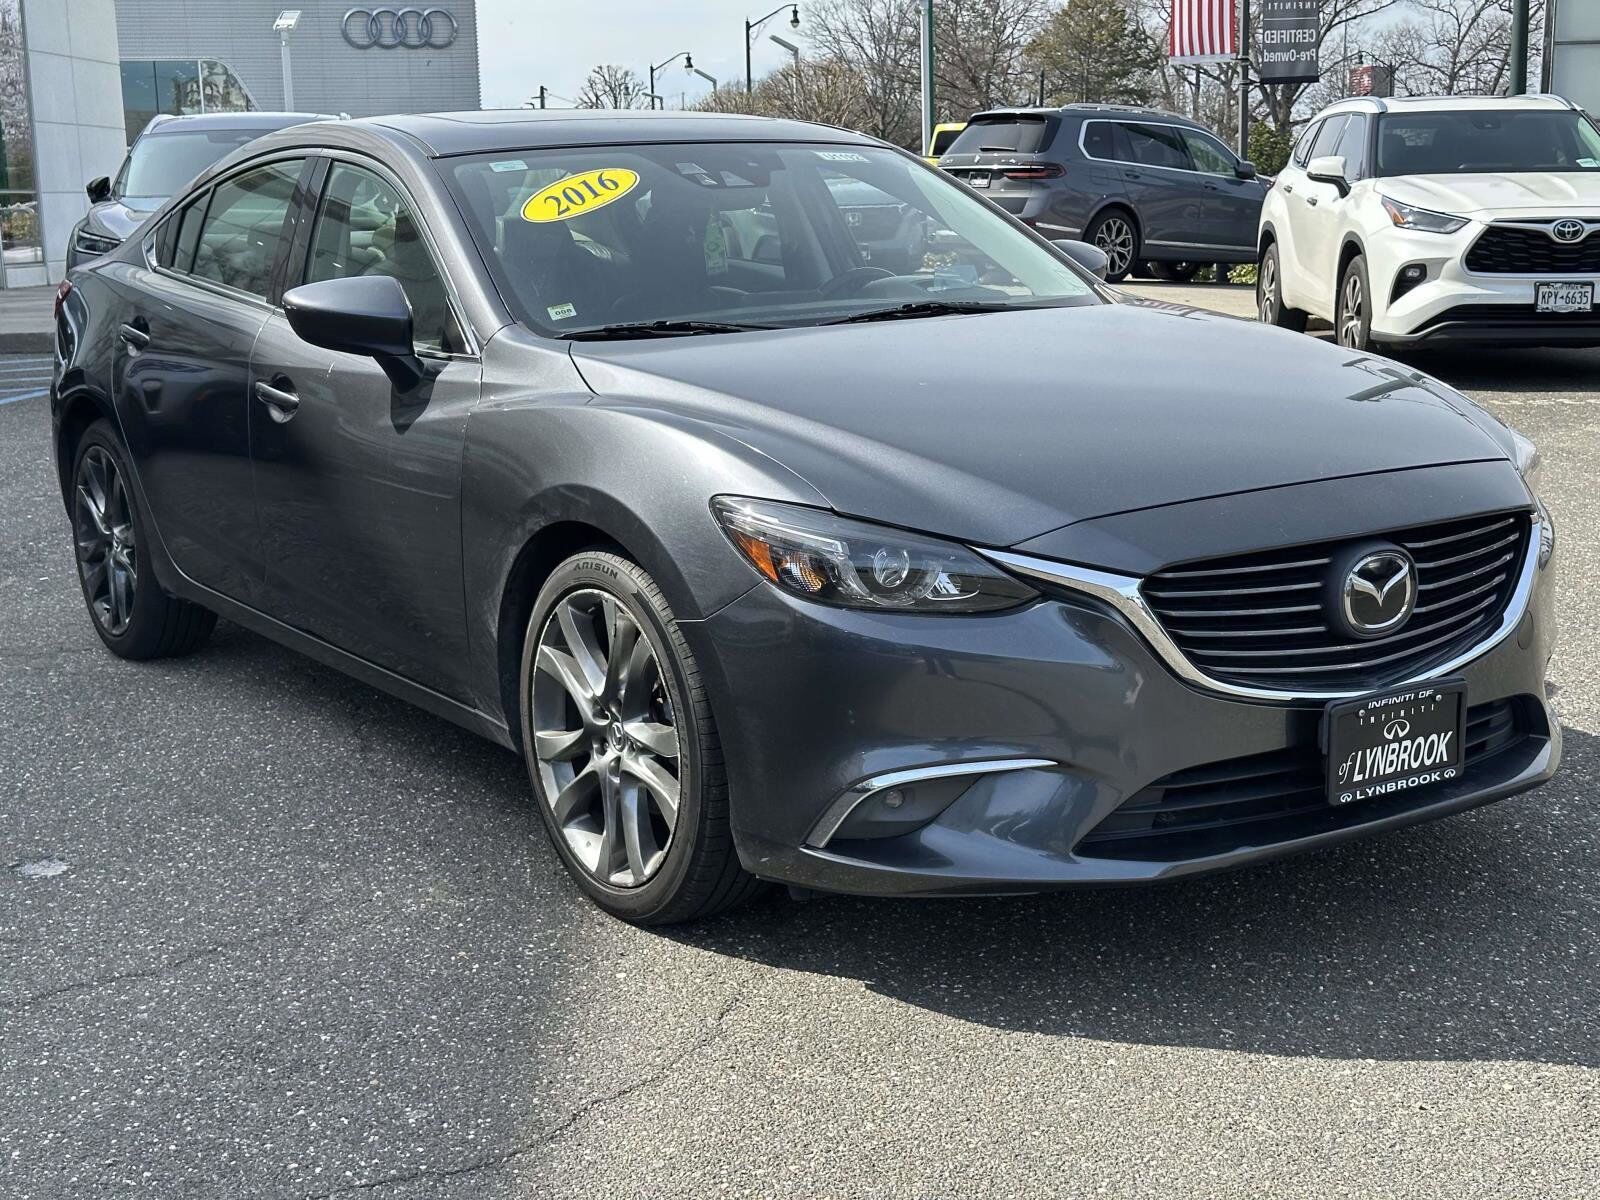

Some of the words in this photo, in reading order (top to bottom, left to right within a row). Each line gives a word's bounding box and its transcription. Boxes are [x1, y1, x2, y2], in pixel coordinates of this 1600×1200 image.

[543, 171, 620, 216] 2016
[574, 561, 619, 579] ARISUN
[1368, 692, 1415, 709] INFINITI
[1418, 689, 1435, 699] OF
[1360, 703, 1435, 725] INFINITI
[1338, 752, 1356, 785] of
[1352, 730, 1453, 782] LYNBROOK
[1356, 771, 1441, 800] LYNBROOK
